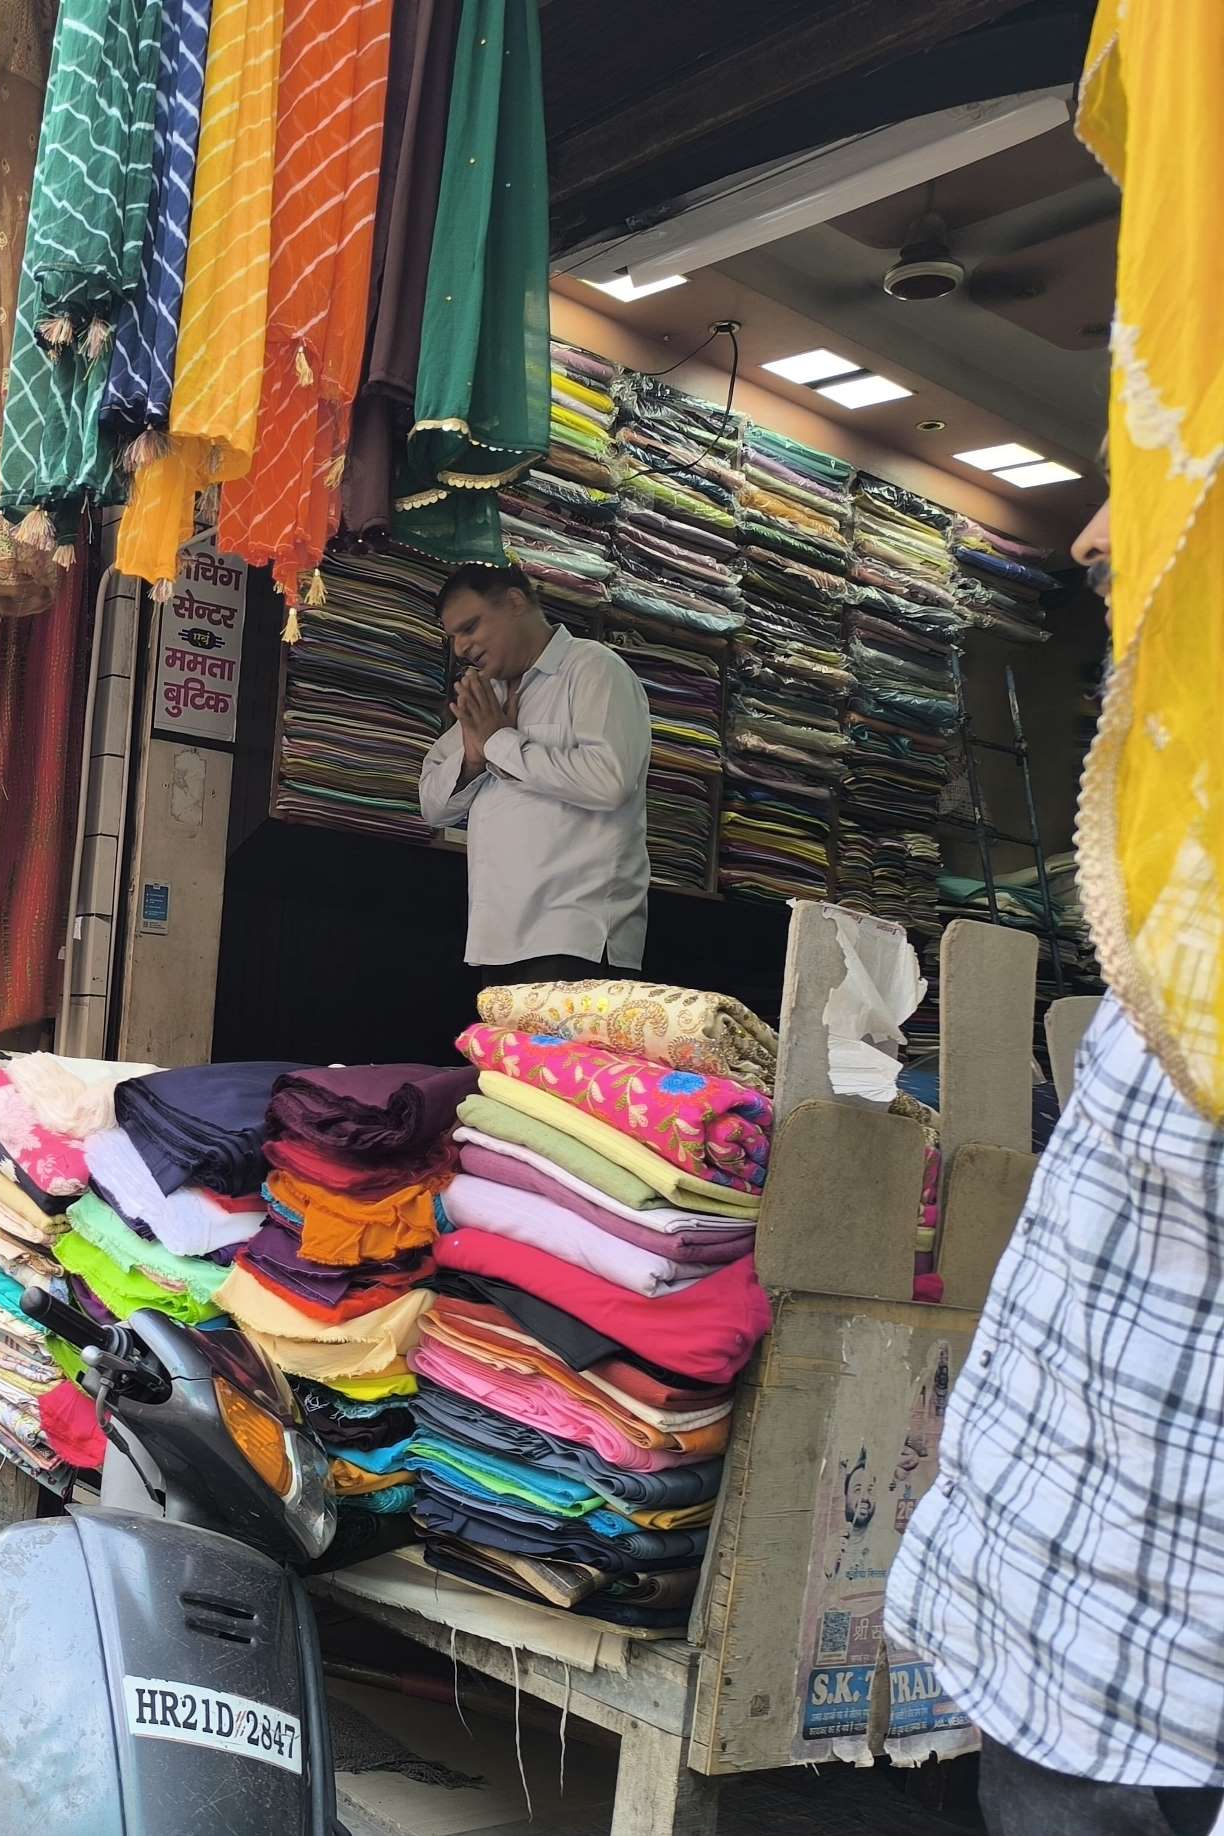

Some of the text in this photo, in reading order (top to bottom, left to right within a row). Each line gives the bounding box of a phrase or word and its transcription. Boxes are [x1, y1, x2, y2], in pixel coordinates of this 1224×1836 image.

[173, 589, 238, 629] सेन्टर
[165, 647, 236, 682] ममता
[163, 677, 233, 718] बुटिक
[865, 1666, 945, 1705] TRAD
